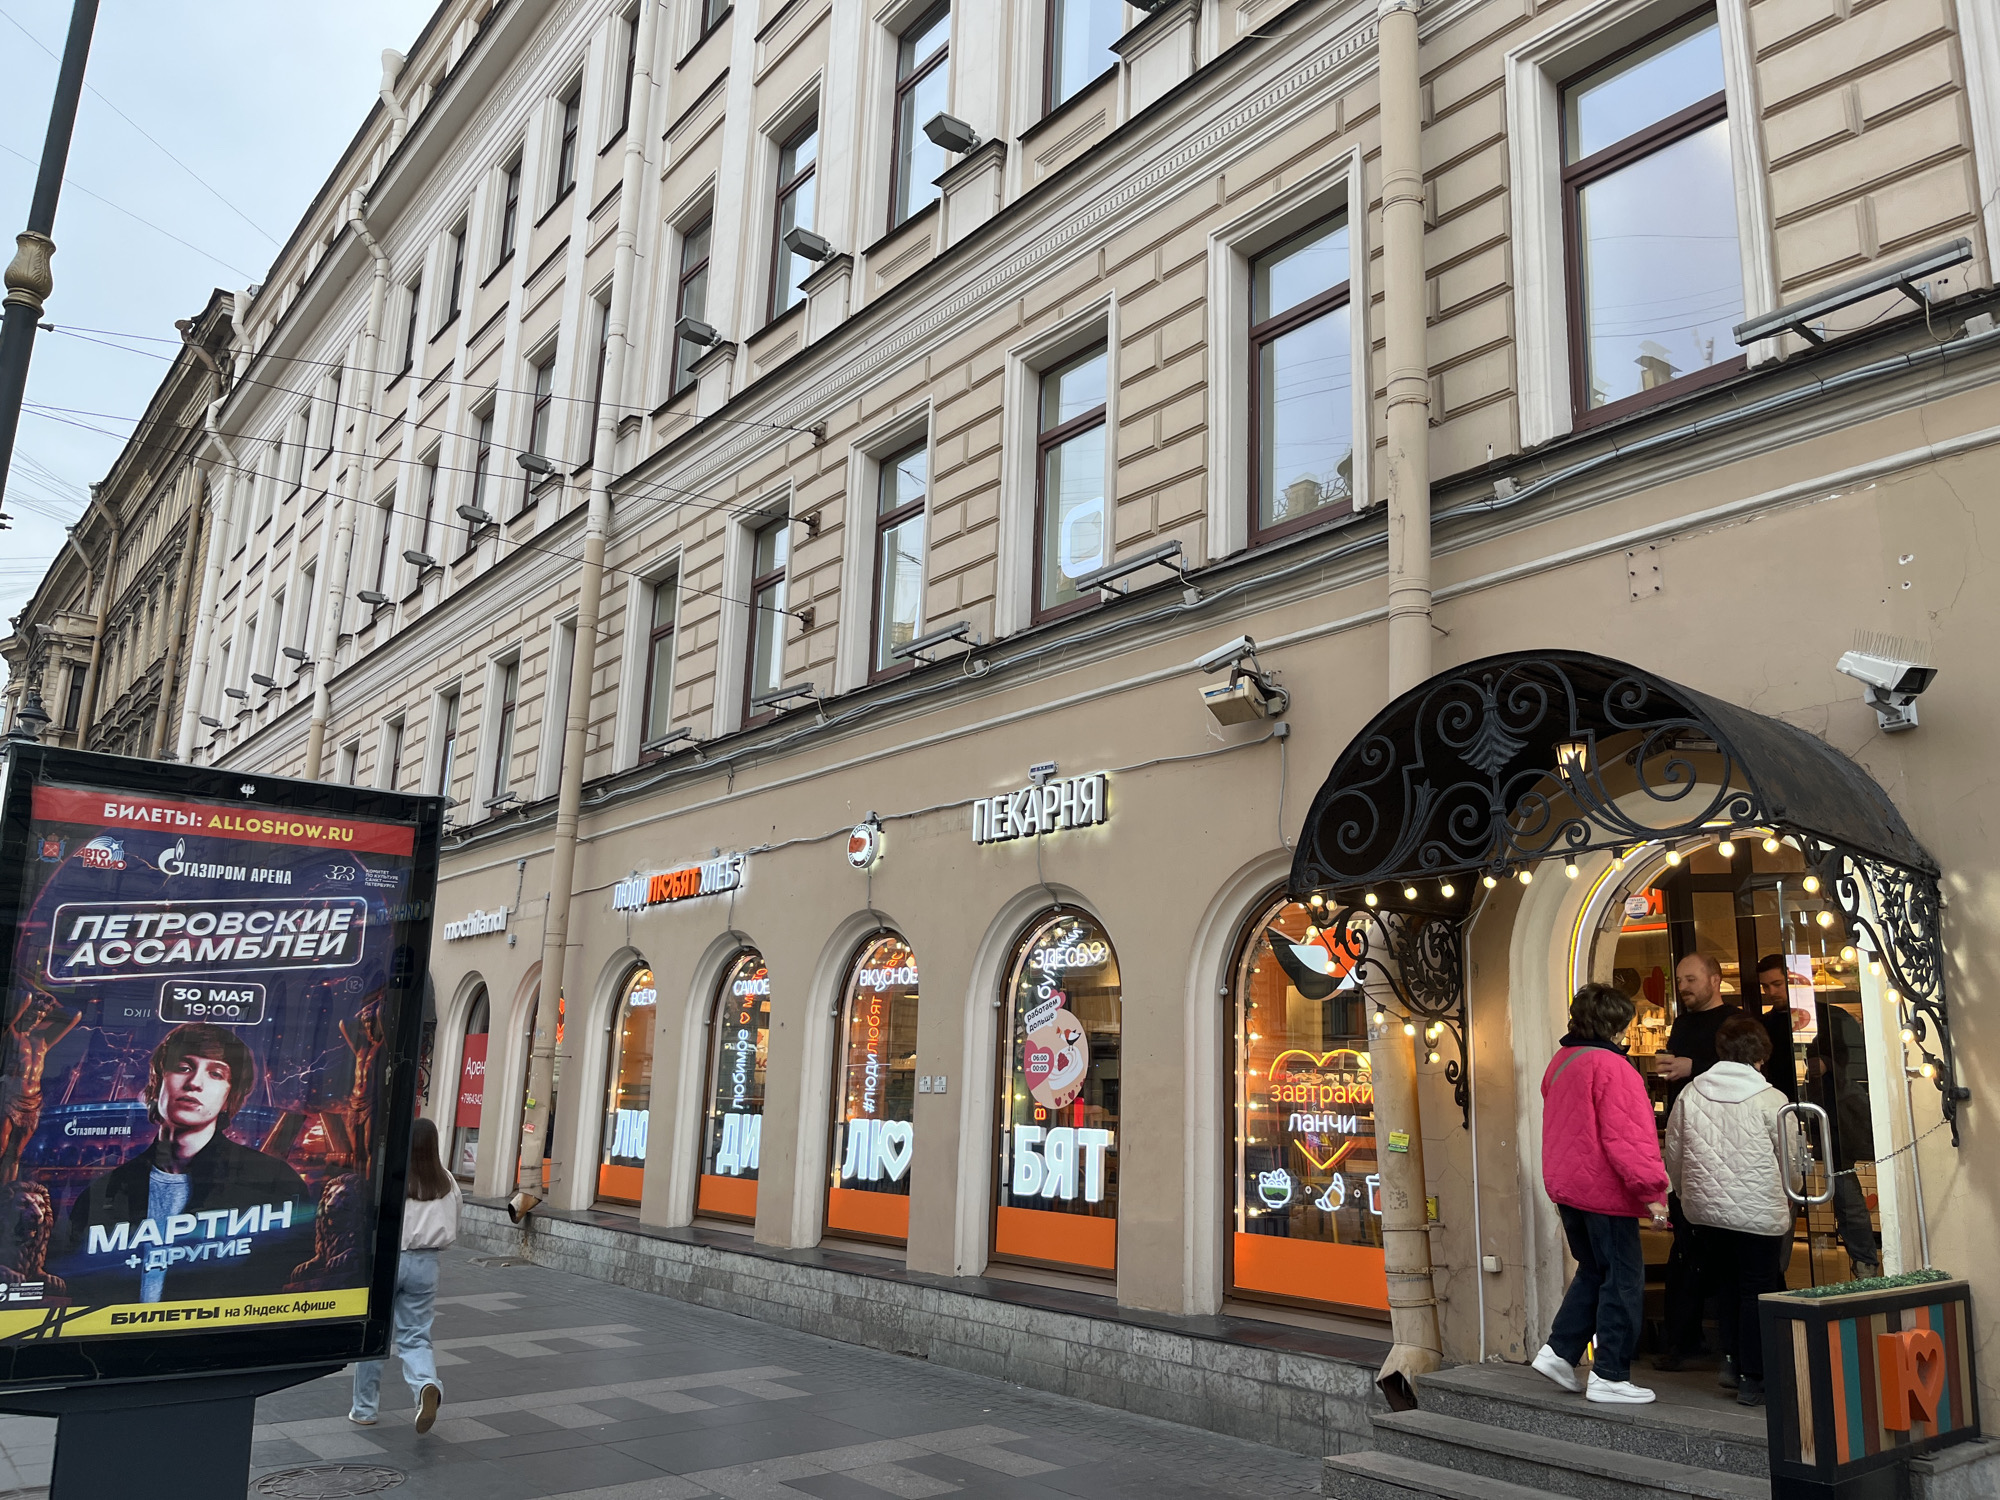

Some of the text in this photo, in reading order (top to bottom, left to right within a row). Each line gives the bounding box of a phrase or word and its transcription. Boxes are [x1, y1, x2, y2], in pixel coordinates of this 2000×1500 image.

[972, 776, 1103, 842] ПЕКАРНЯ
[103, 802, 355, 843] БИЛЕТЫ: ALLOSHOW.RU
[74, 847, 110, 860] АВТО
[82, 857, 128, 871] РАДИО
[184, 862, 292, 885] ГАЗПРОМ АРЕНА
[612, 877, 648, 911] ЛЮДИ
[699, 858, 739, 893] ХЛЕБ
[67, 907, 355, 942] ПЕТРОВСКИЕ
[443, 904, 508, 941] mochiland
[64, 932, 348, 968] АССАМБЛЕИ
[1033, 945, 1088, 969] ЗДЕСЬ
[733, 978, 770, 997] САМОЕ
[859, 966, 919, 992] ВКУСНОЕ
[173, 988, 254, 1003] 30 МАЯ
[184, 1003, 241, 1017] 19:00
[1026, 998, 1058, 1022] работаем
[1029, 1012, 1055, 1032] дольше
[732, 1028, 750, 1110] любимое
[1269, 1083, 1374, 1109] завтраки
[76, 1126, 131, 1136] ГАЗПРОМ АРЕНА
[612, 1109, 650, 1160] ЛЮ
[1288, 1113, 1357, 1134] ланчи
[715, 1112, 763, 1176] ДИ
[1013, 1124, 1112, 1203] БЯТ
[88, 1201, 293, 1255] МАРТИН
[125, 1237, 252, 1272] + ДРУГИЕ
[110, 1299, 336, 1326] БИЛЕТЫ на Яндекс Афише
